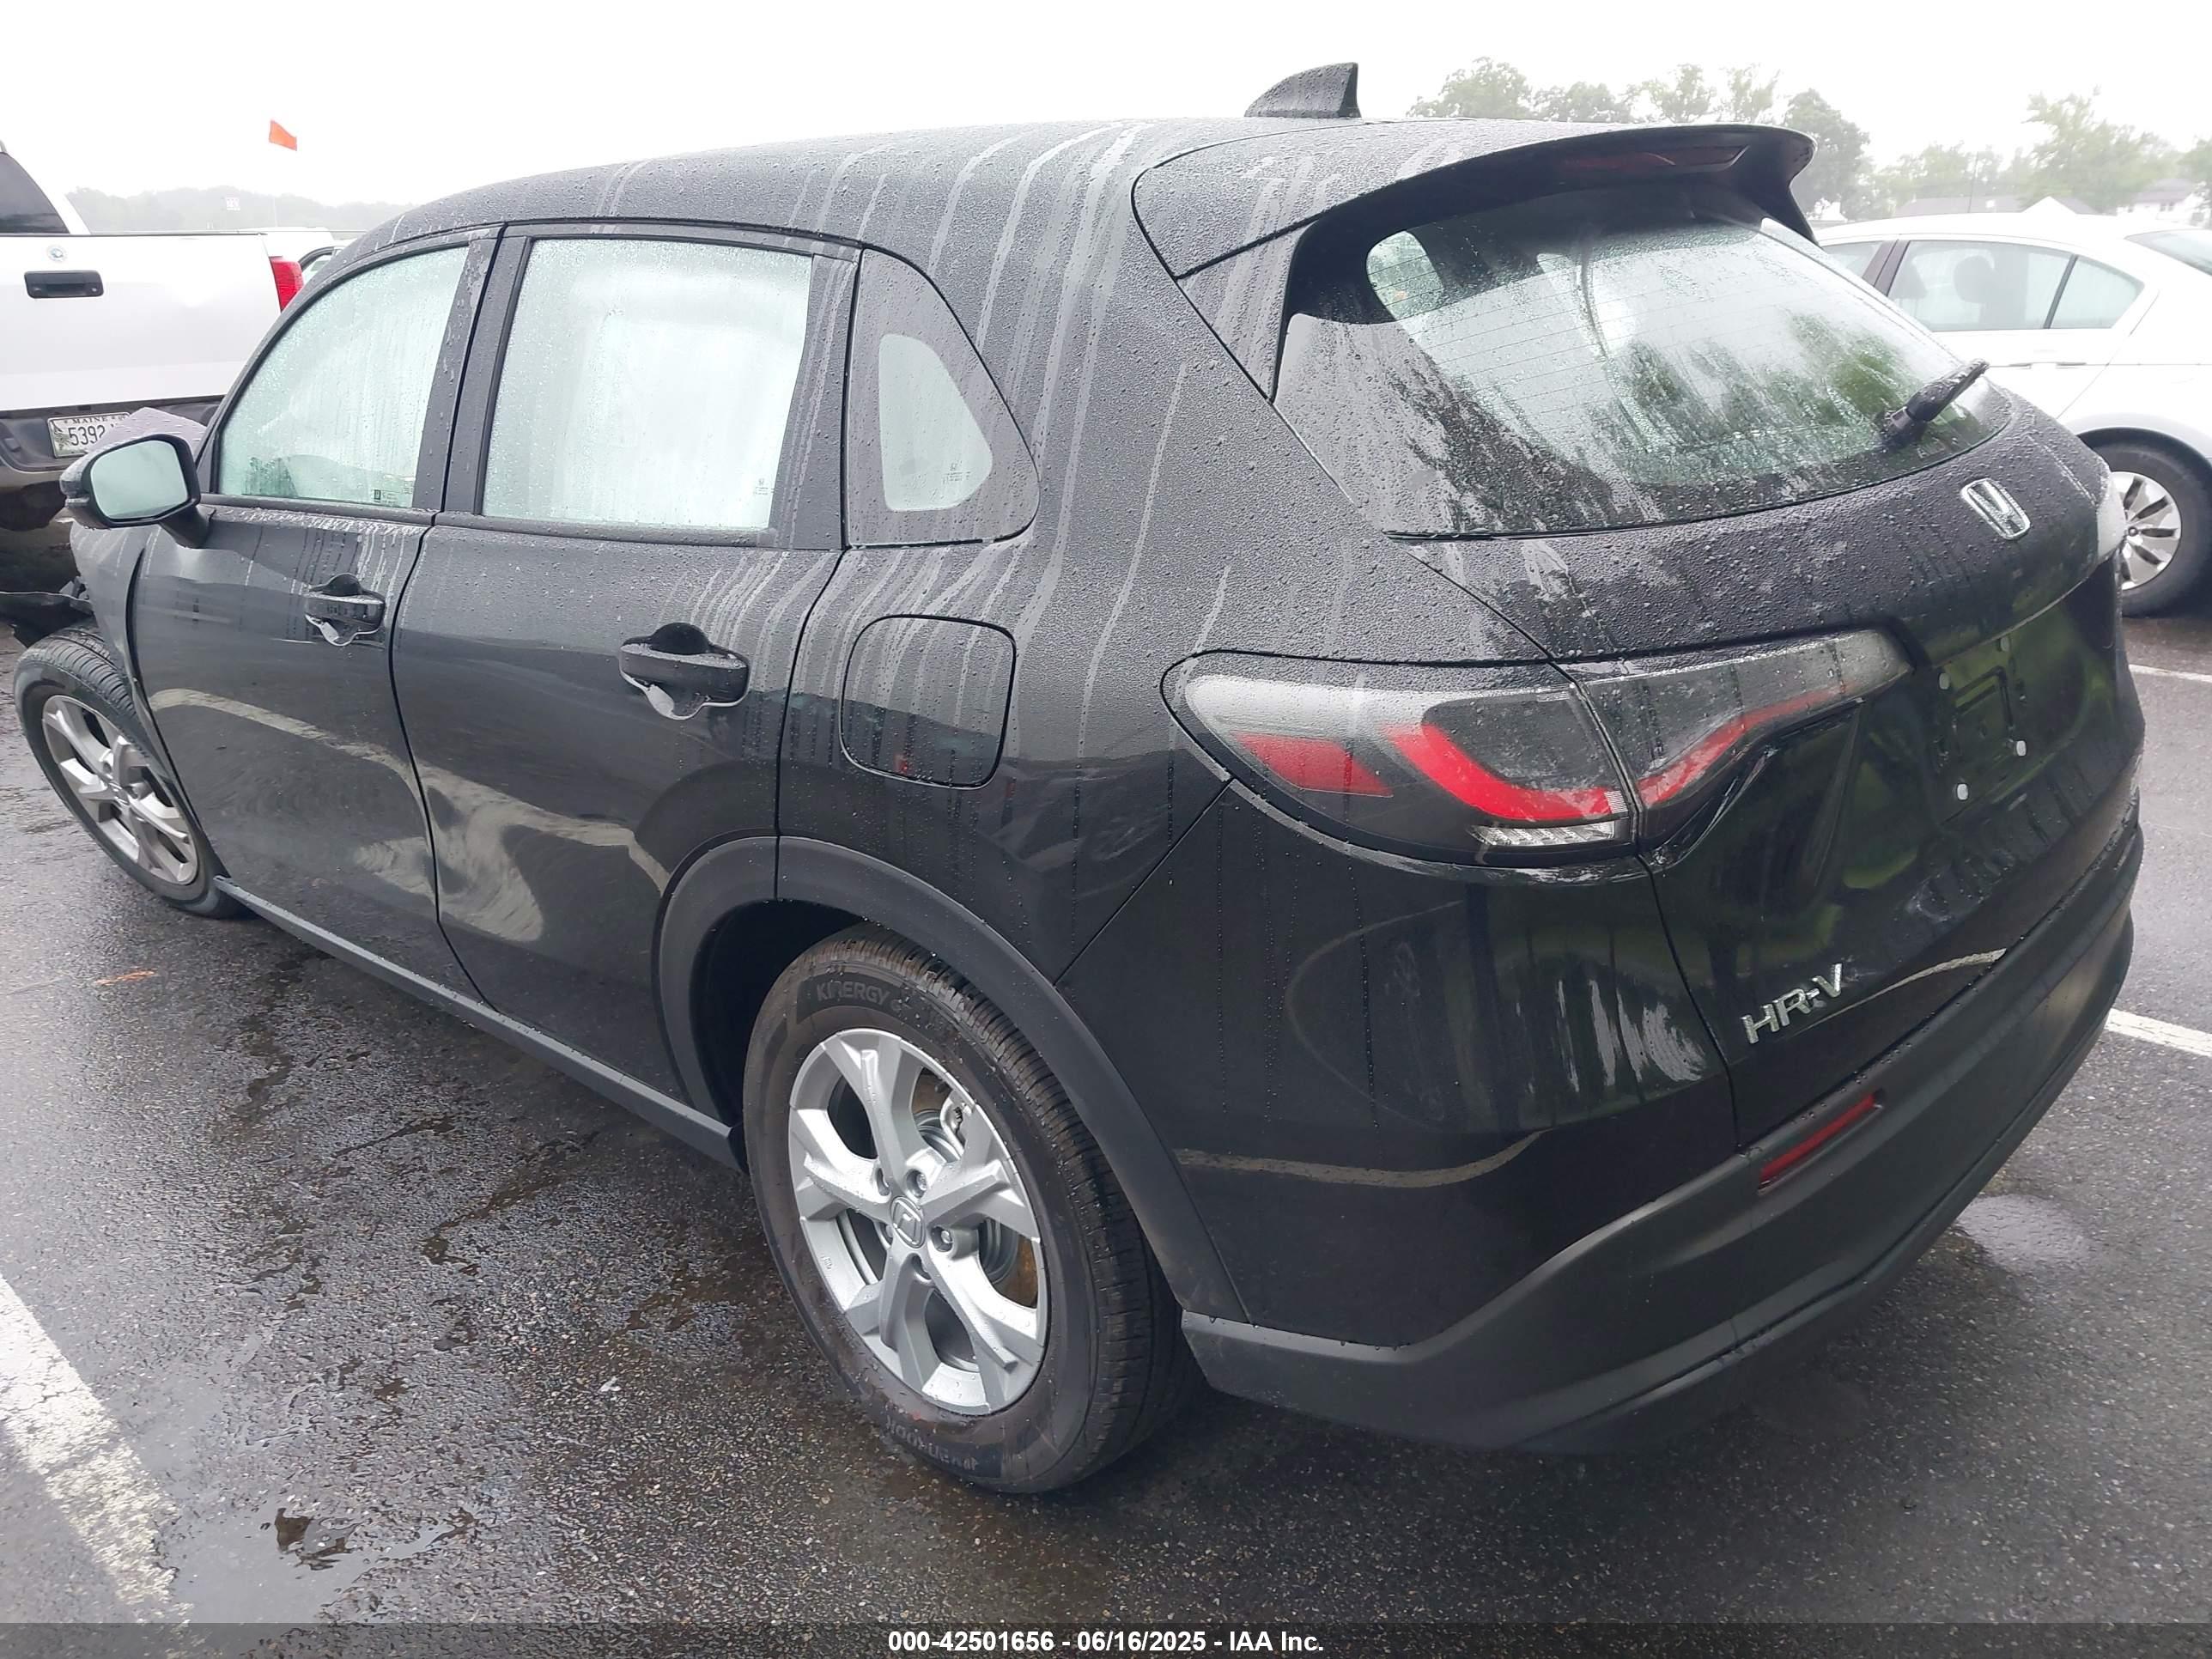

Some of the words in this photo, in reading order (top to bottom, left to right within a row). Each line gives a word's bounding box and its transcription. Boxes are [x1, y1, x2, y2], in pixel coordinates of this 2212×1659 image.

[72, 416, 108, 424] MAINE
[68, 424, 106, 446] 5392
[1741, 963, 1843, 1044] HR-V
